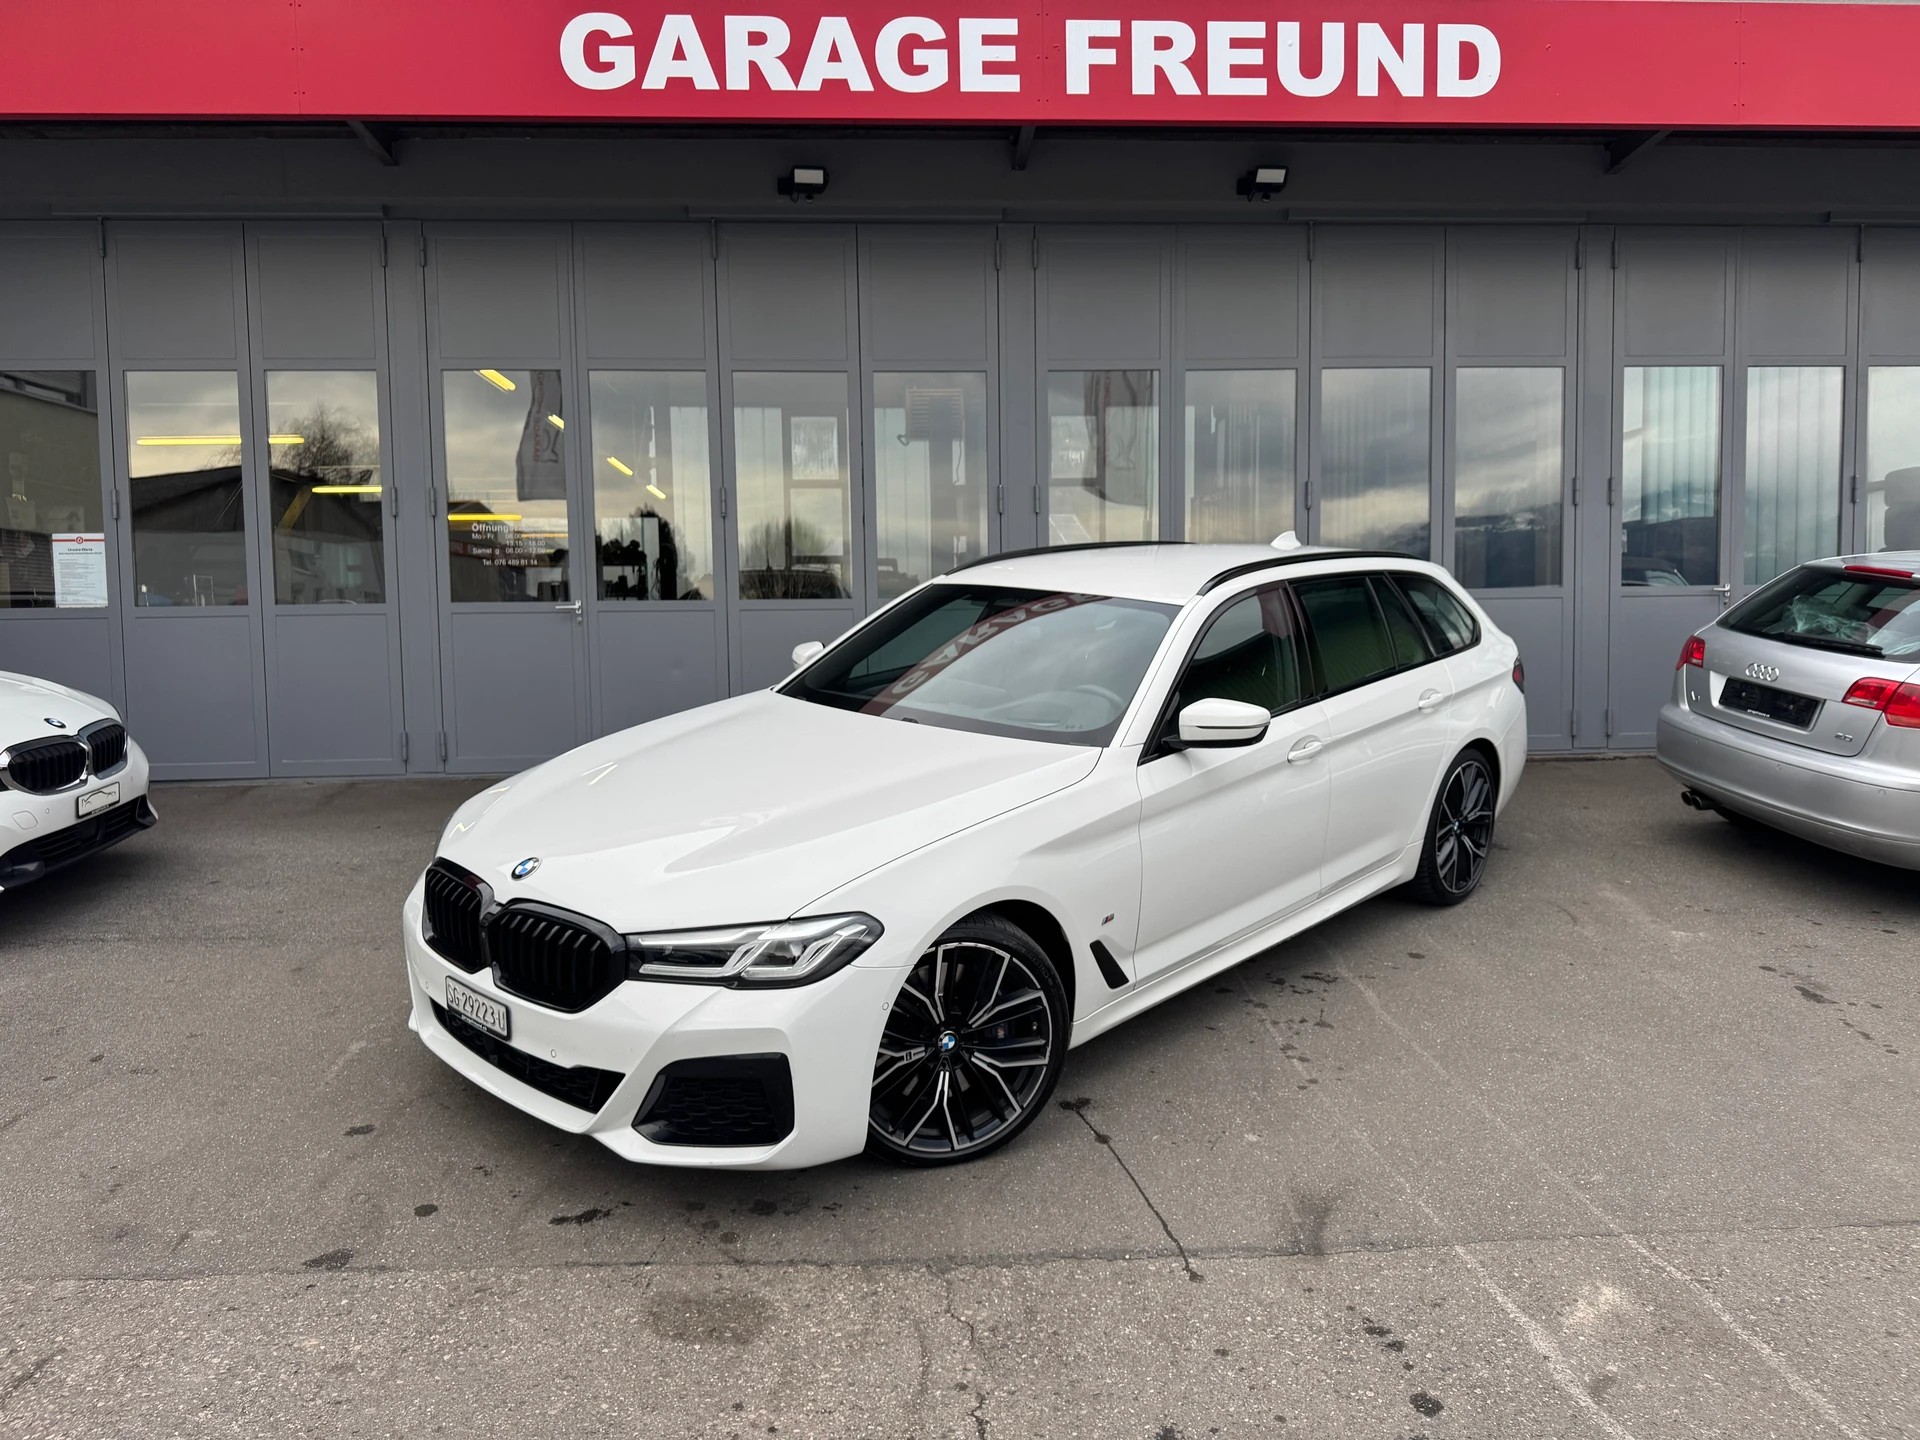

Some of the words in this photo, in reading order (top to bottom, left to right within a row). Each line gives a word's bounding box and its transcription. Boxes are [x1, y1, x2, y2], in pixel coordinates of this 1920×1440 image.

[559, 12, 1021, 93] GARAGE
[1065, 19, 1501, 97] FREUND
[472, 547, 500, 555] Samstg
